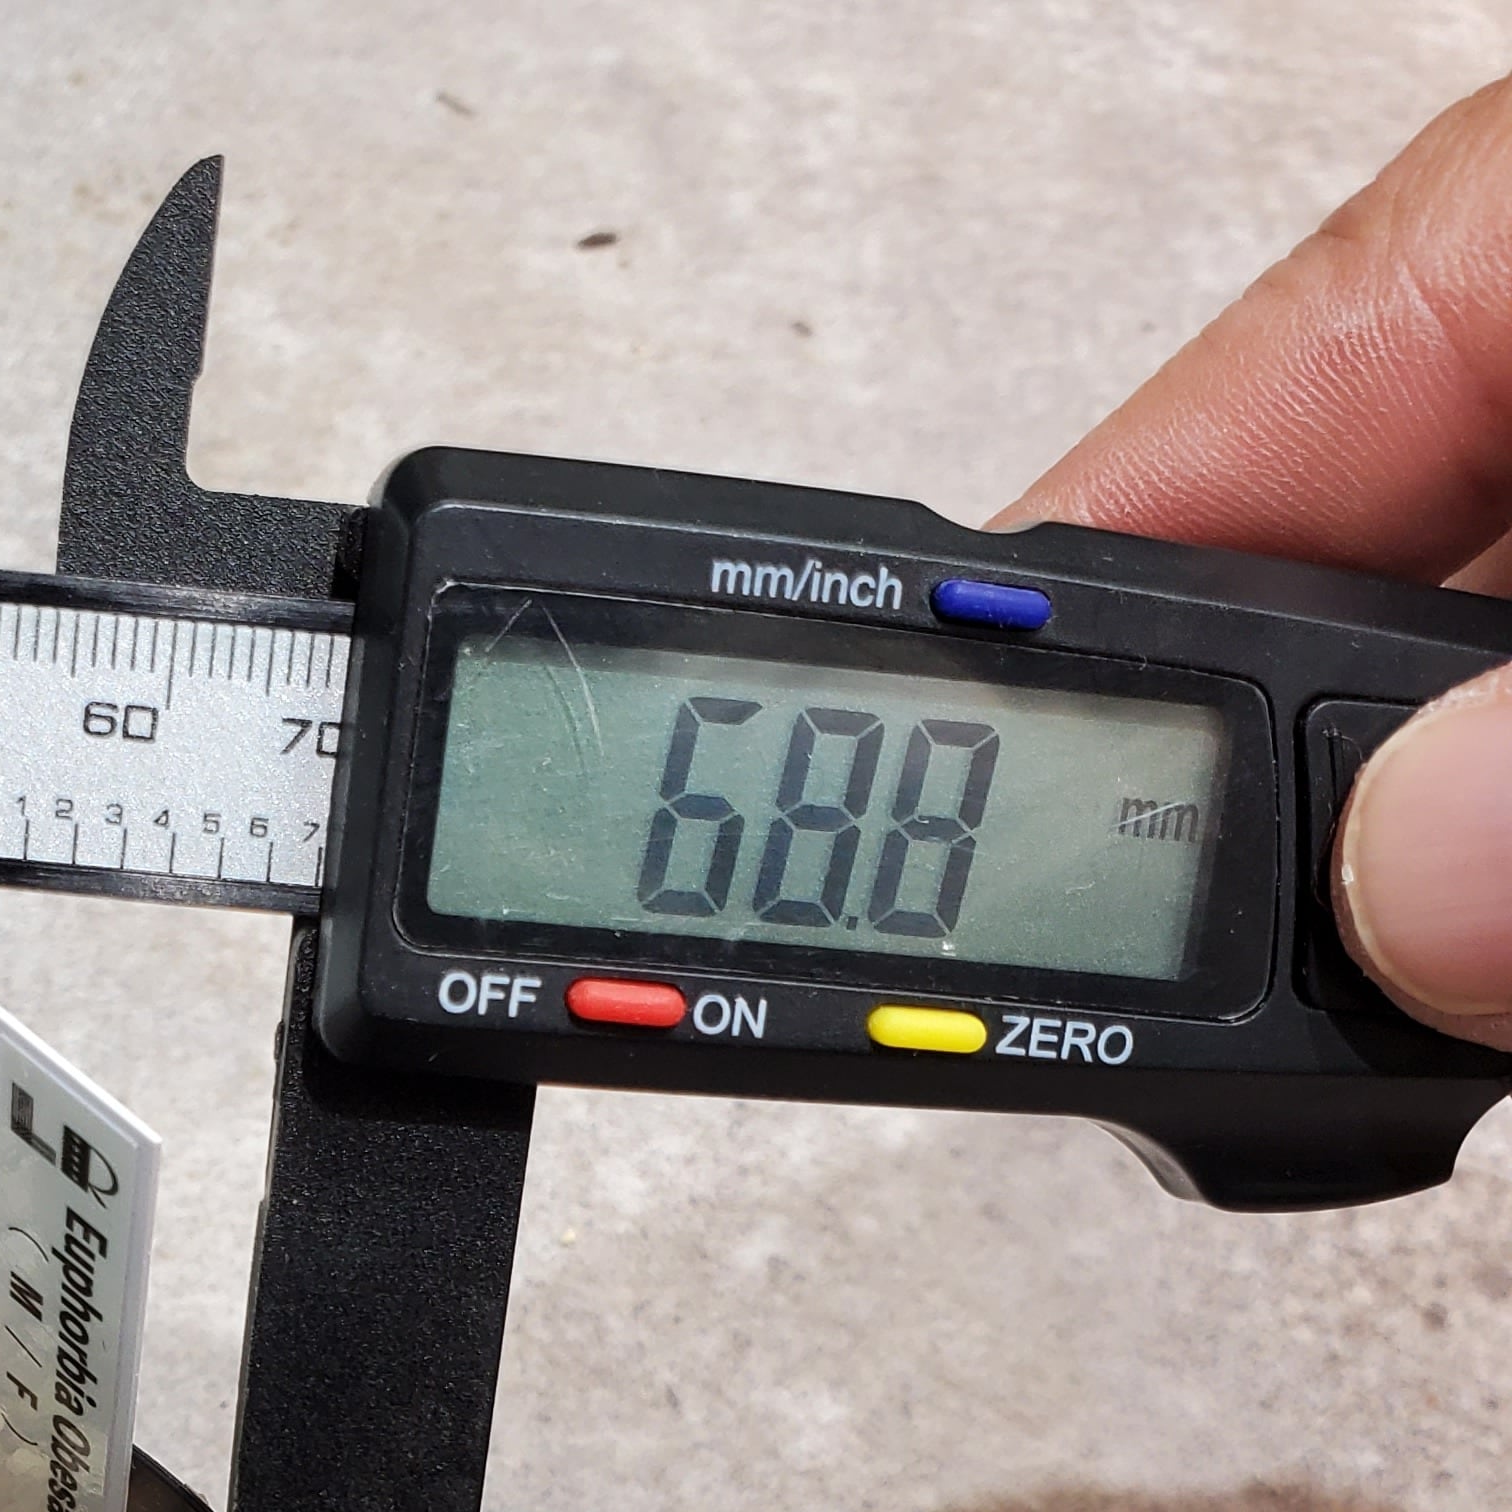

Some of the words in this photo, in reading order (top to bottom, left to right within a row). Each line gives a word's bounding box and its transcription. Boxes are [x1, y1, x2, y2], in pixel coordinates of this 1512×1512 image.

[711, 559, 903, 610] mm/inch
[83, 701, 159, 742] 60
[16, 797, 27, 816] 1
[55, 800, 74, 818] 2
[105, 804, 123, 825] 3
[154, 810, 169, 828] 4
[204, 813, 221, 834] 5
[250, 818, 268, 838] 6
[302, 822, 320, 843] 7
[637, 696, 1001, 938] 68.8
[1119, 797, 1200, 842] mm
[438, 971, 542, 1019] OFF
[693, 994, 768, 1039] ON
[995, 1015, 1134, 1065] ZERO
[51, 1206, 108, 1416] Euphorbia
